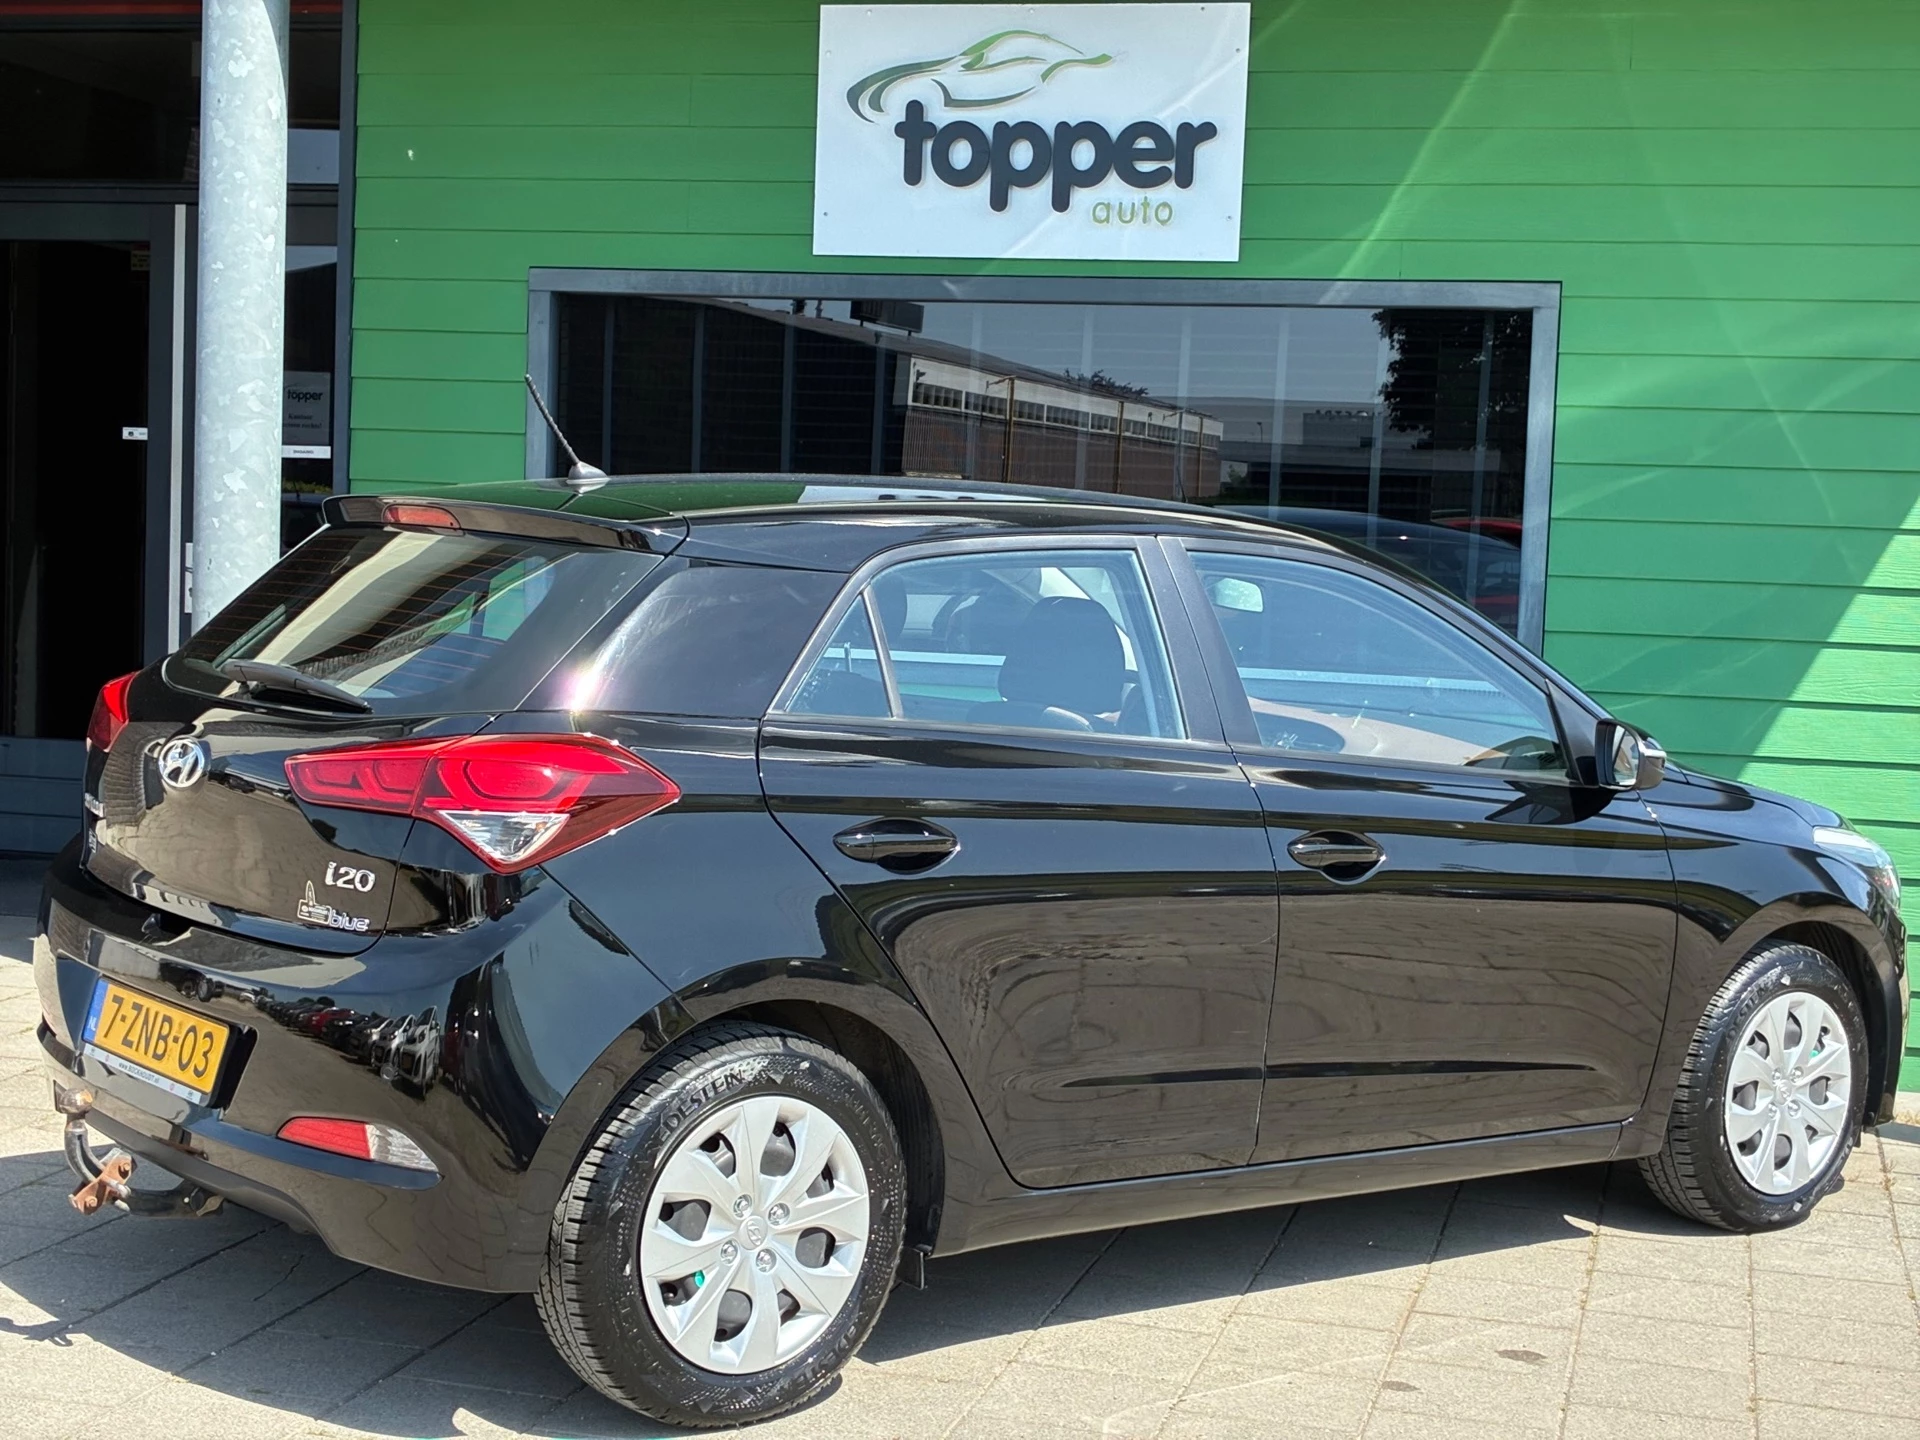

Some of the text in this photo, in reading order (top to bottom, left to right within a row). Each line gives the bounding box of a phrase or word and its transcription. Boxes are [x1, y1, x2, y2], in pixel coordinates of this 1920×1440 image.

[894, 99, 1218, 213] topper
[1092, 196, 1174, 226] auto
[288, 389, 323, 403] topper
[324, 861, 376, 893] i20
[329, 909, 371, 932] blue
[87, 1015, 98, 1032] NL
[103, 993, 214, 1079] 7-ZNB-03
